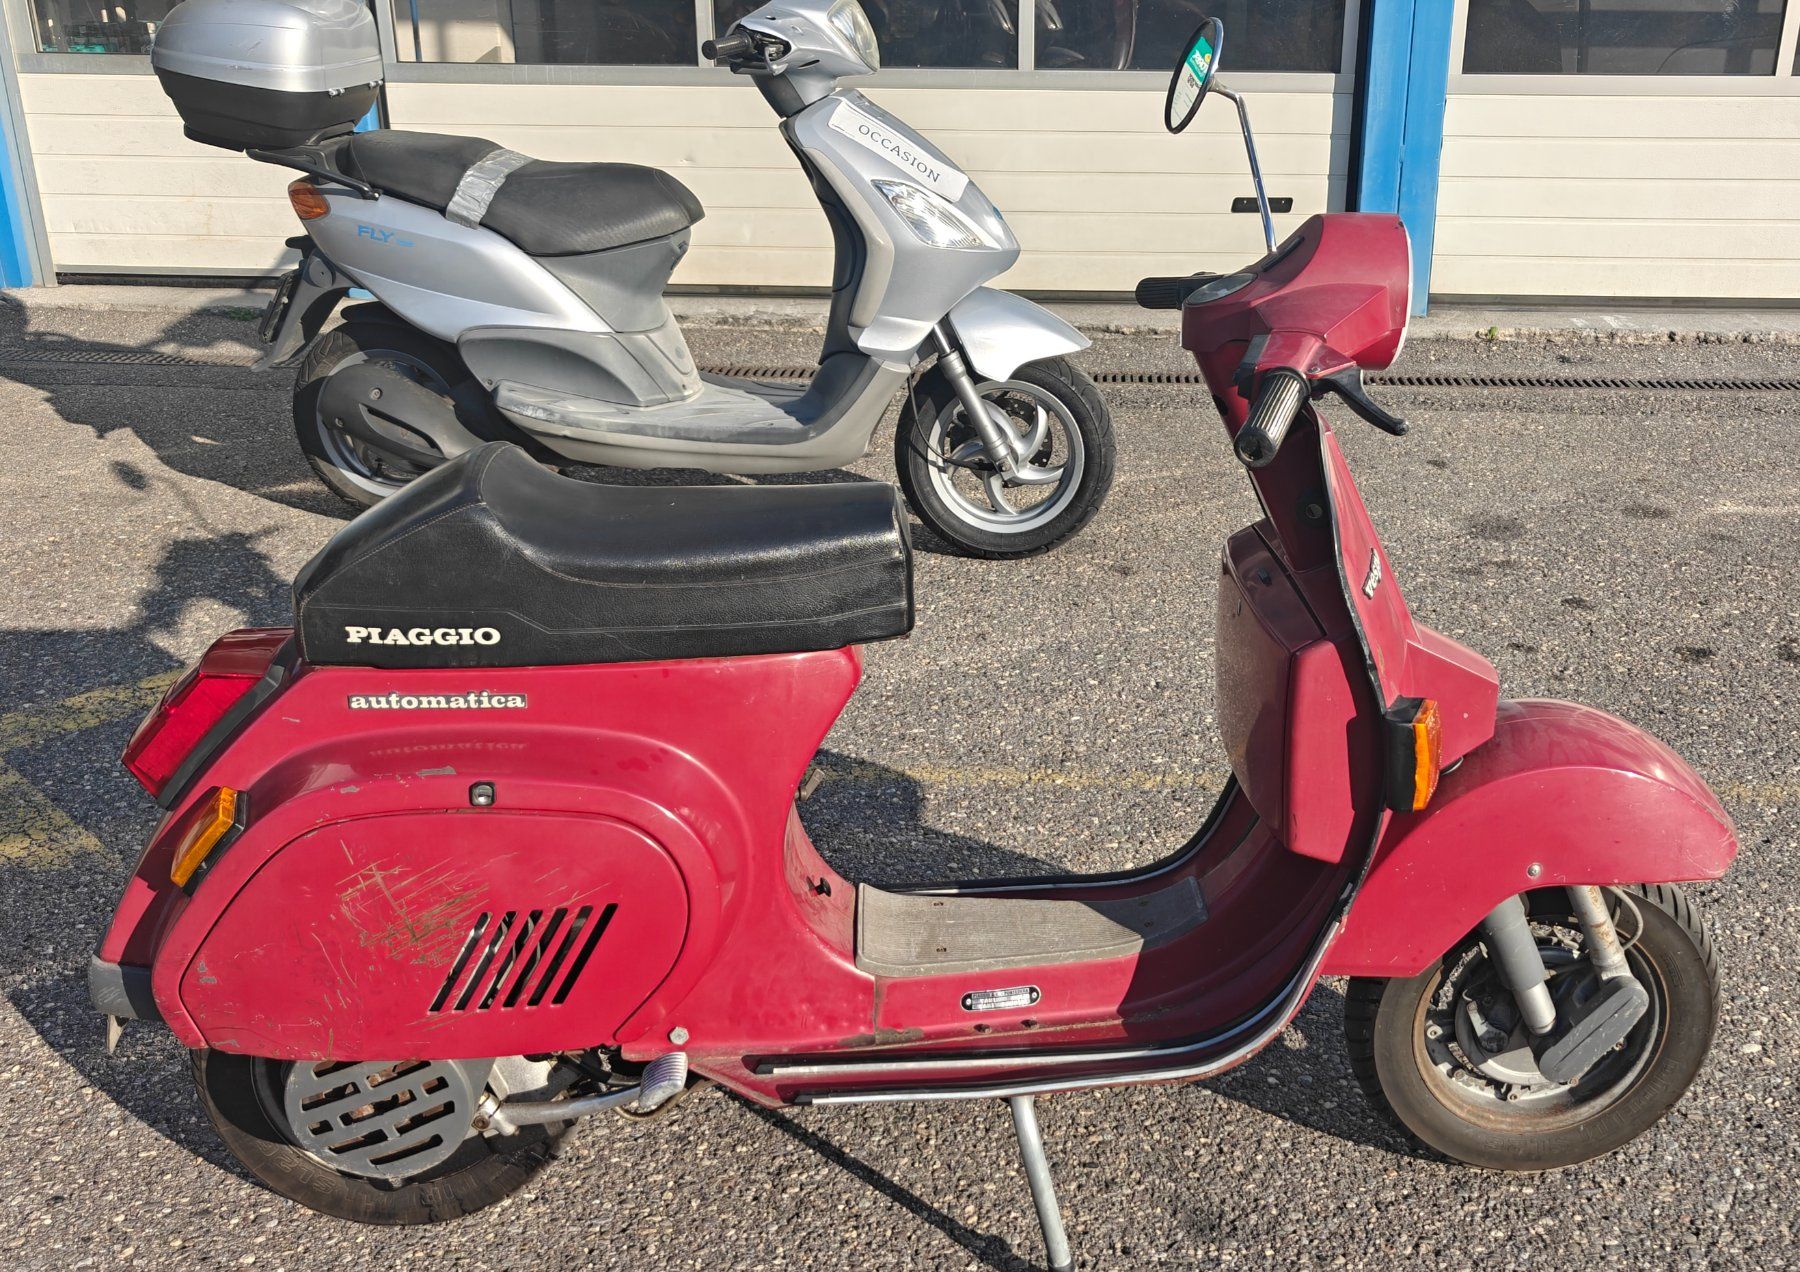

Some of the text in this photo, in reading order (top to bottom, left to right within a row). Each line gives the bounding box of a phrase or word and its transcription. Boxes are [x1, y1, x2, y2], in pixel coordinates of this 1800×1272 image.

[858, 124, 941, 183] OCCASION
[357, 224, 394, 243] FLY
[345, 626, 501, 646] PIAGGIO
[350, 692, 525, 709] automatica
